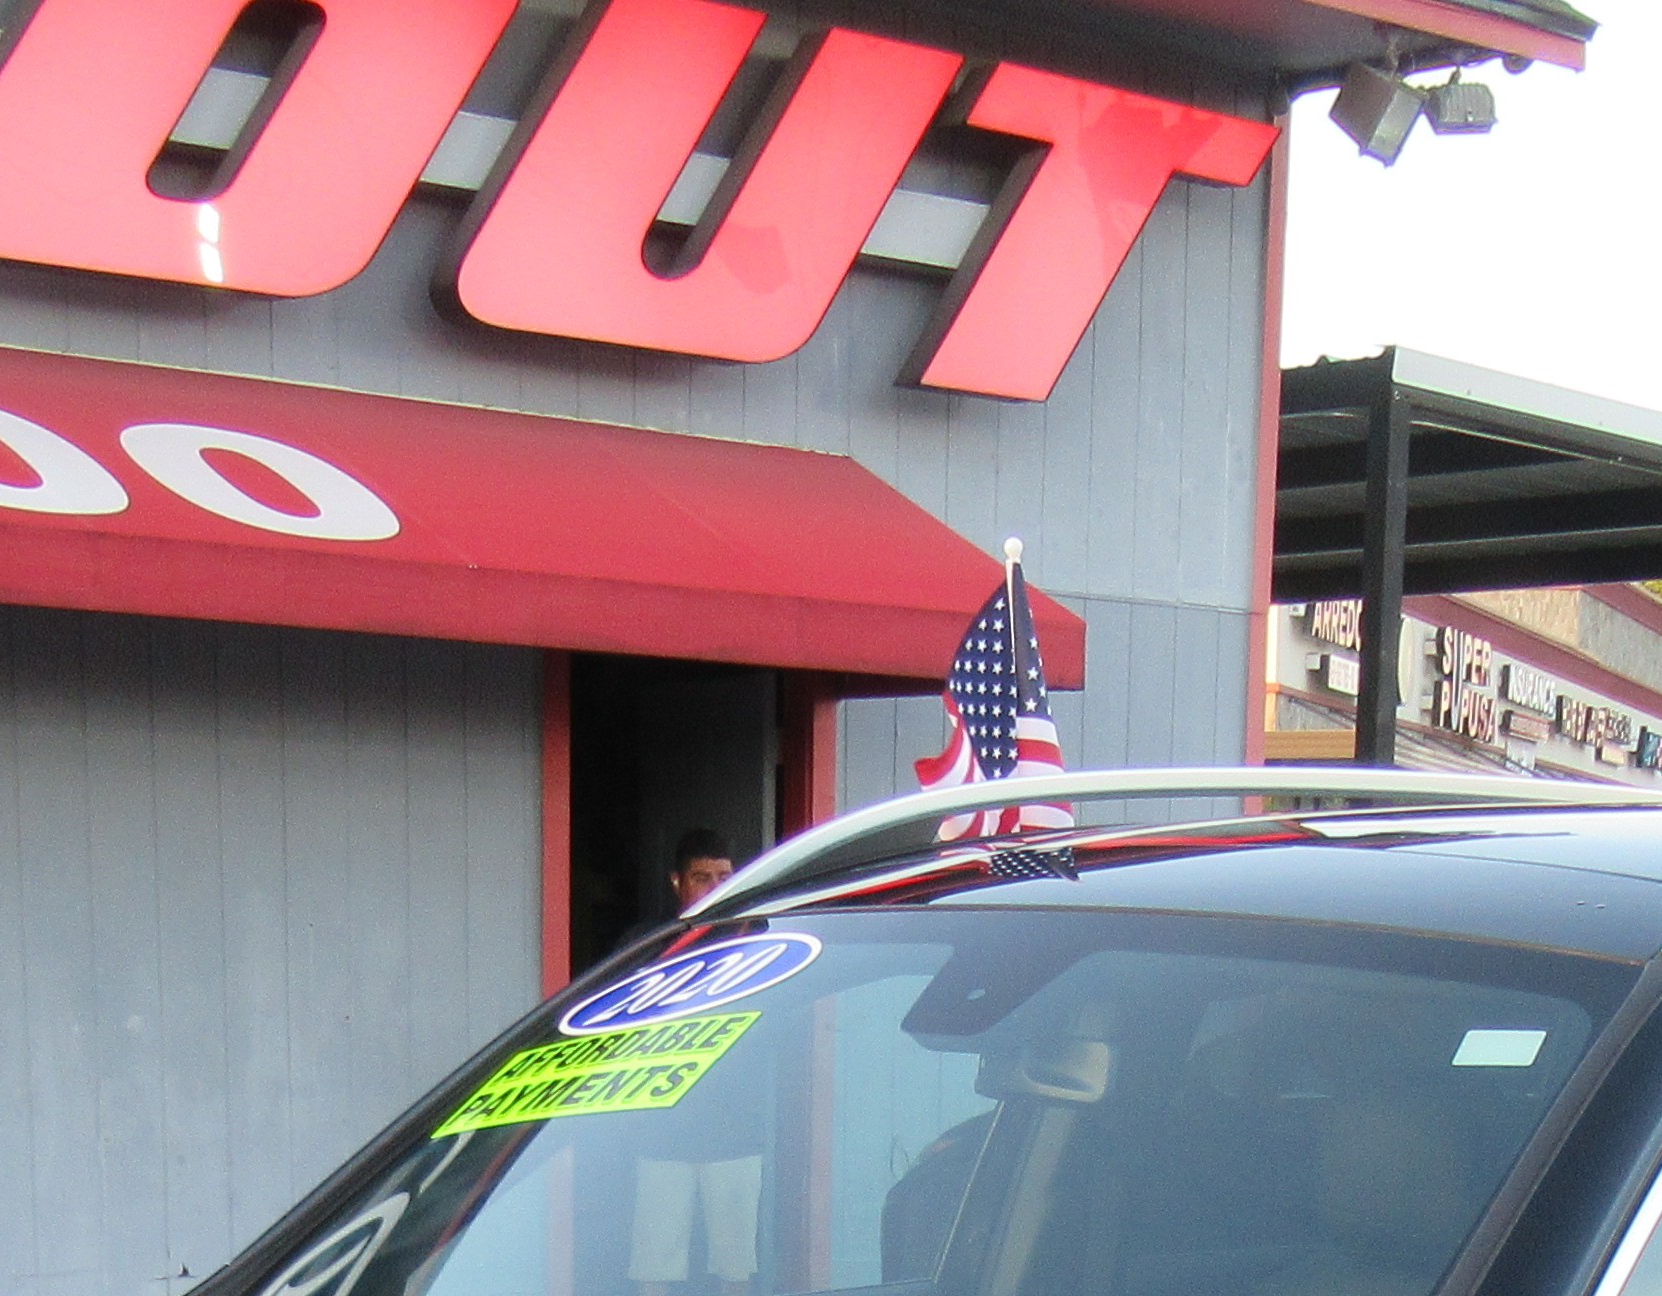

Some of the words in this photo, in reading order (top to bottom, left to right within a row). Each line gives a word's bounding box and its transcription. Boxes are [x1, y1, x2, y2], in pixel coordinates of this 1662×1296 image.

[1441, 626, 1492, 688] SUPER
[583, 942, 788, 1027] 2020
[493, 1016, 745, 1084] AFFORDABLE
[451, 1061, 699, 1123] PAYMENTS
